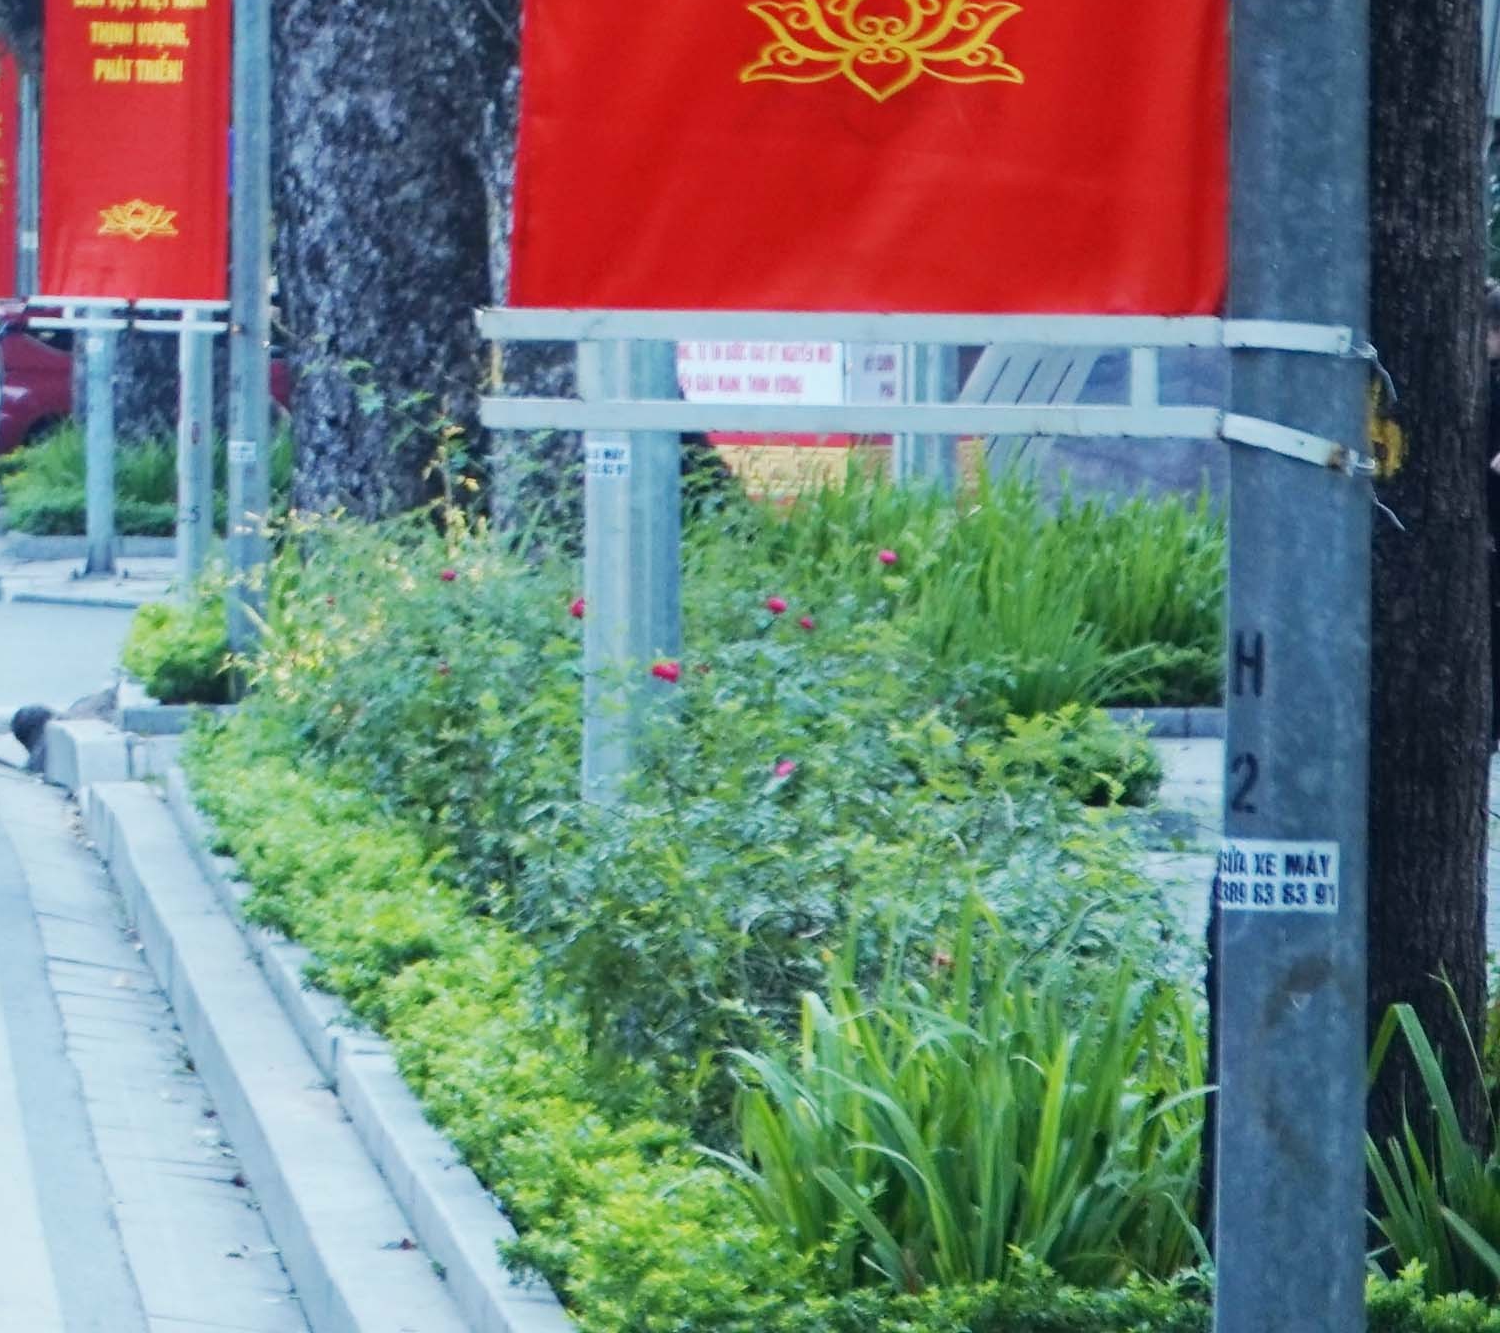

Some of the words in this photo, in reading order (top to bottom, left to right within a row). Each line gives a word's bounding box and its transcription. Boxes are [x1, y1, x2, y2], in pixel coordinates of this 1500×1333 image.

[1235, 630, 1264, 698] H
[1232, 752, 1259, 814] 2
[1254, 852, 1277, 875] XE
[1285, 850, 1331, 877] MÁY
